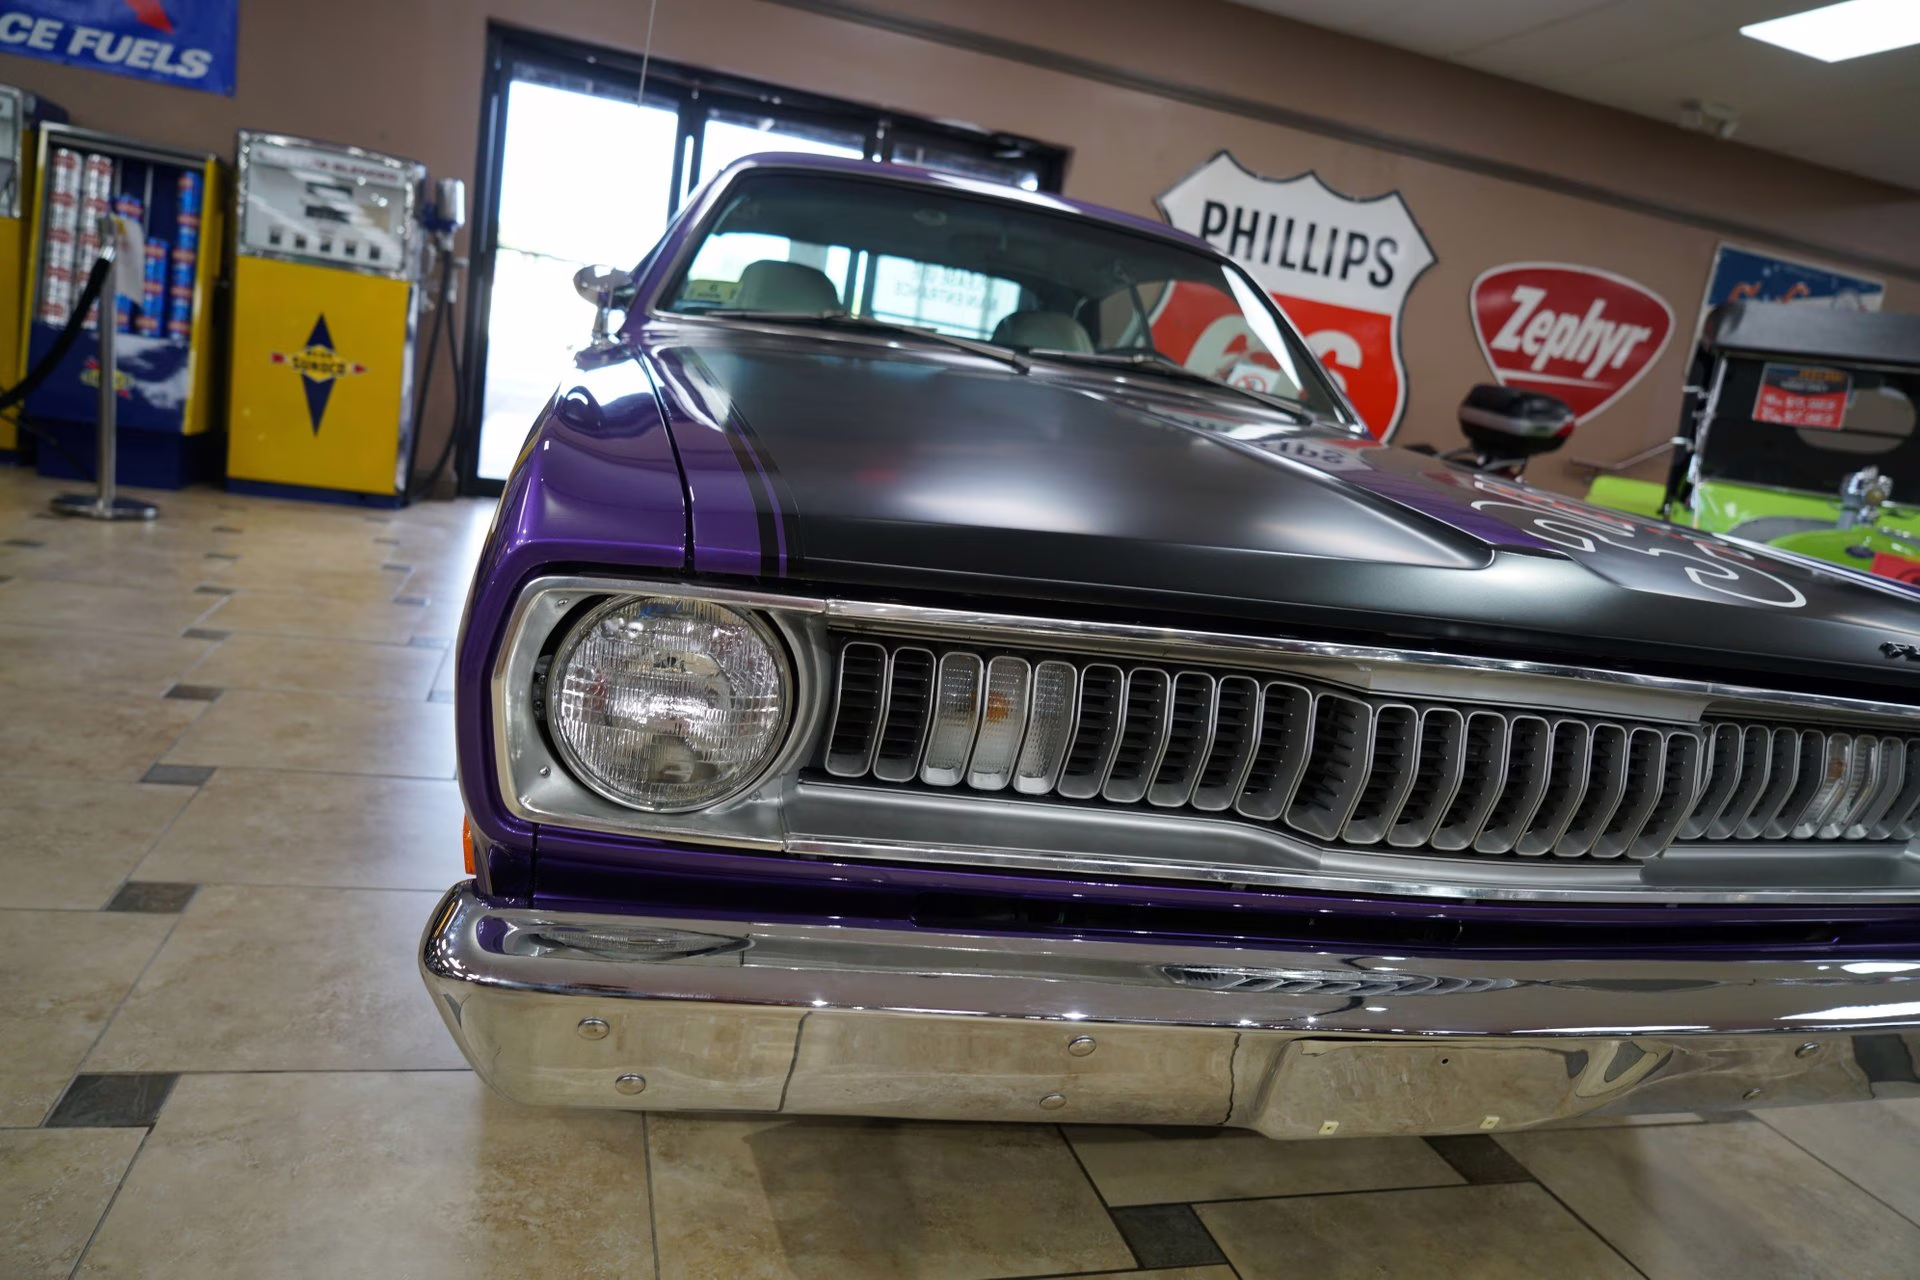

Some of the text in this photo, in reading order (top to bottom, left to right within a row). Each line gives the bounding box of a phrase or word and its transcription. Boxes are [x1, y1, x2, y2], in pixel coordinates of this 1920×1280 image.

[66, 25, 214, 79] FUELS
[1201, 200, 1399, 289] PHILLIPS
[1490, 284, 1653, 381] Zephyr
